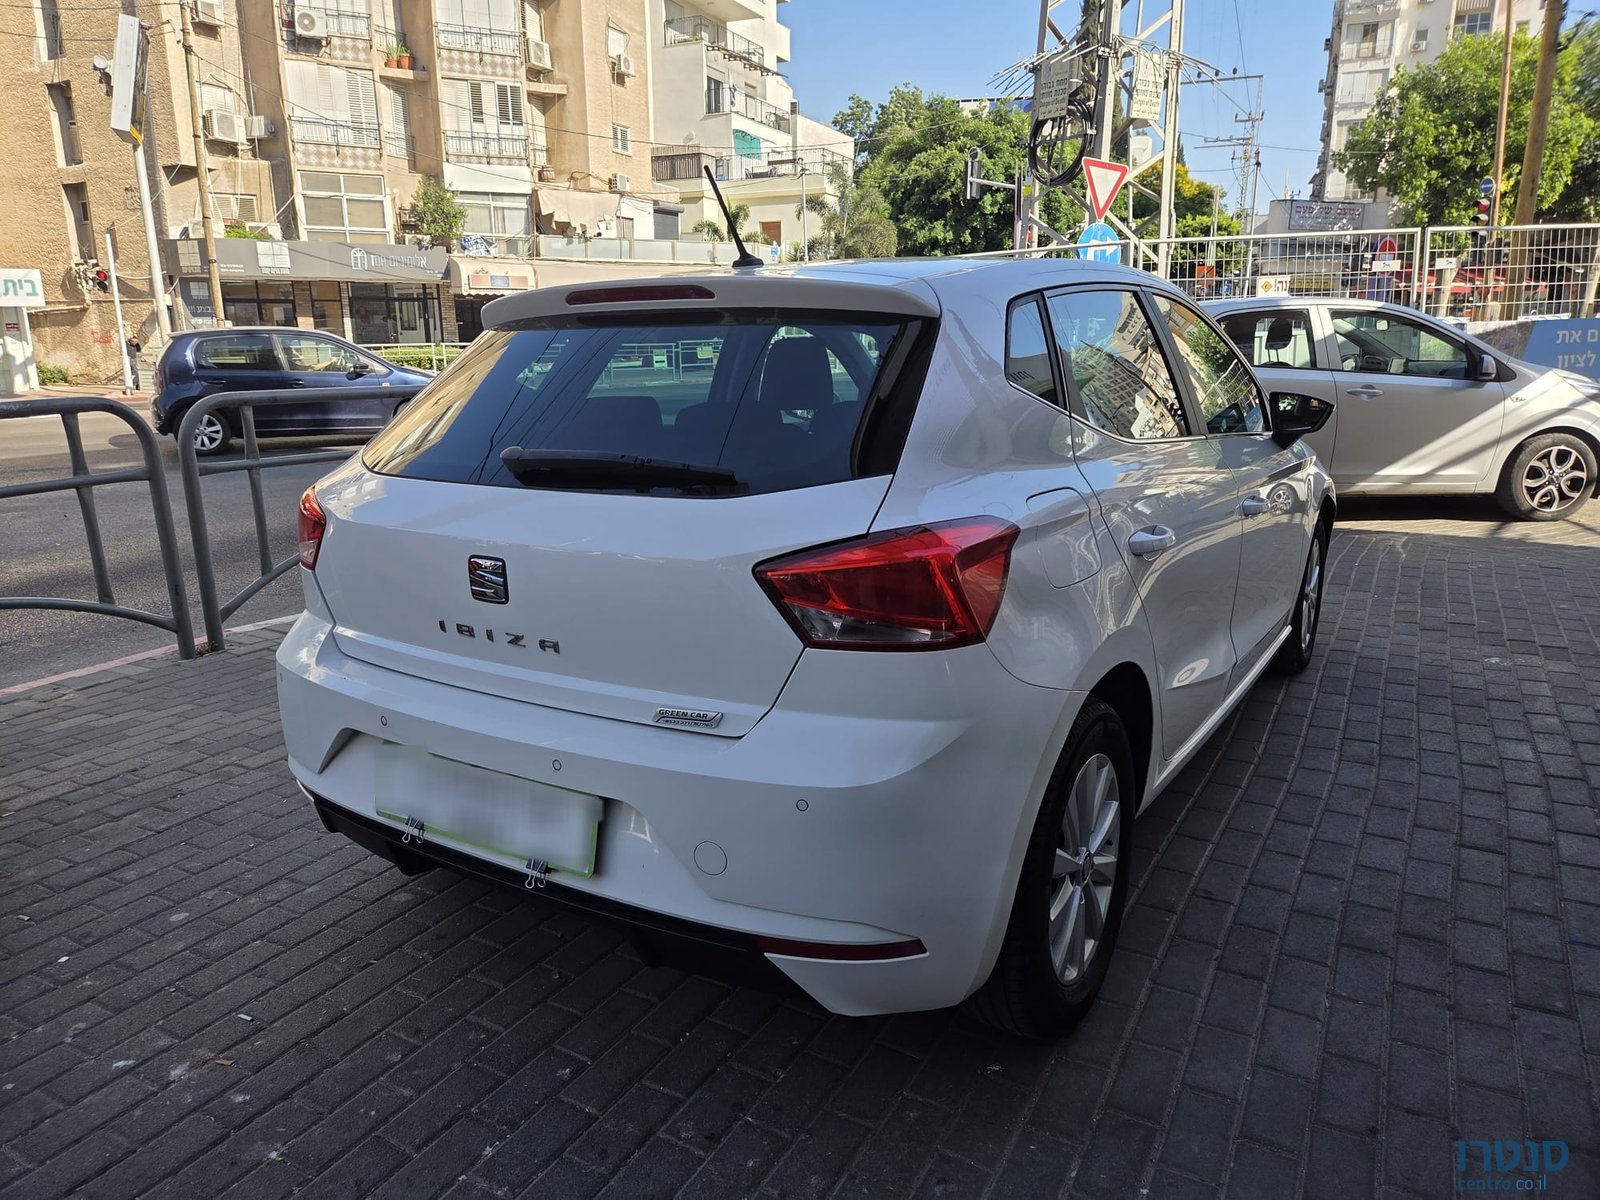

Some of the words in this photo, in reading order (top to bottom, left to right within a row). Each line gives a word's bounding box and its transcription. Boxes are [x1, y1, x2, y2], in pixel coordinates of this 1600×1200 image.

[3, 279, 39, 296] בית
[1556, 329, 1582, 344] את
[1557, 349, 1597, 368] לציון
[439, 620, 560, 654] IBIZA
[658, 708, 688, 718] GREEN
[690, 711, 709, 720] CAR
